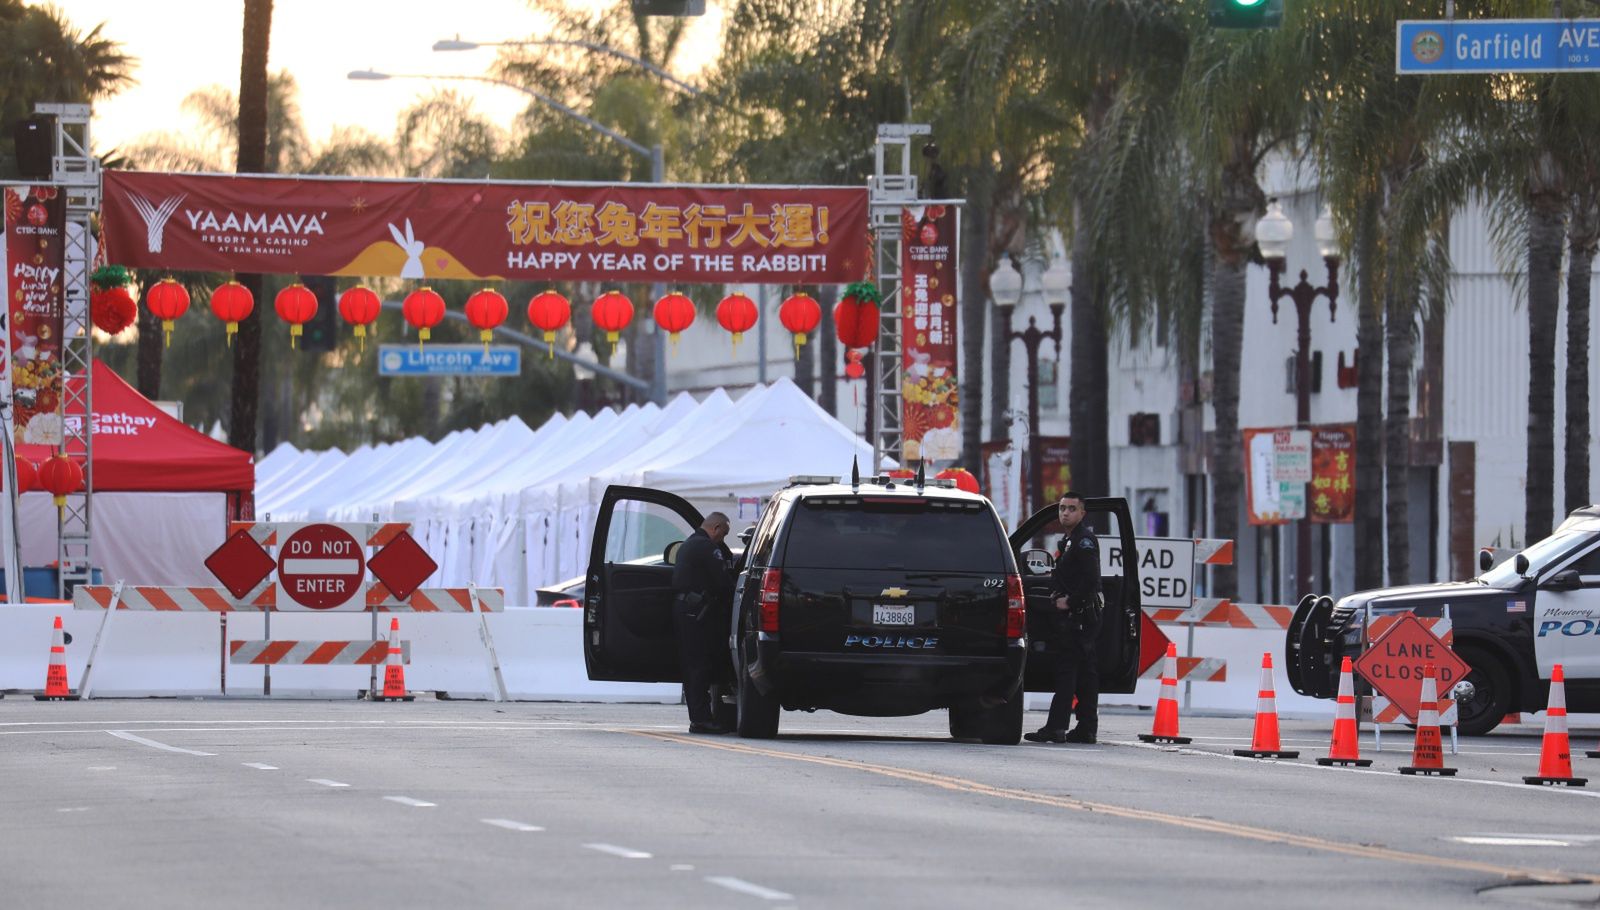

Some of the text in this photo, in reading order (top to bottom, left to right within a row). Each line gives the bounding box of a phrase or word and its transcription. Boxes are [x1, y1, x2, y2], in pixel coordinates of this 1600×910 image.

[1456, 28, 1600, 60] Garfield AVE
[1568, 54, 1590, 63] 100 S
[507, 200, 829, 248] 祝您兔年行大運!
[16, 226, 58, 236] CTBC BANK
[202, 235, 309, 247] RESORT & CASINO
[256, 247, 292, 255] MANUEL
[929, 246, 949, 254] BANK
[507, 251, 827, 272] HAPPY YEAR OF THE RABBIT!
[14, 263, 60, 287] Happy
[408, 350, 512, 366] Lincoln Ave
[92, 412, 157, 428] Cathay
[92, 424, 138, 436] Bank
[1274, 432, 1291, 445] NO
[291, 541, 352, 554] DO NOT
[1109, 547, 1174, 569] RAD
[297, 579, 346, 593] ENTER
[983, 579, 1005, 588] 092
[874, 611, 913, 624] 1438868
[1543, 608, 1593, 618] Monterey
[844, 635, 939, 649] POLICE
[1386, 642, 1436, 659] LANE
[1371, 664, 1453, 682] CLOSD
